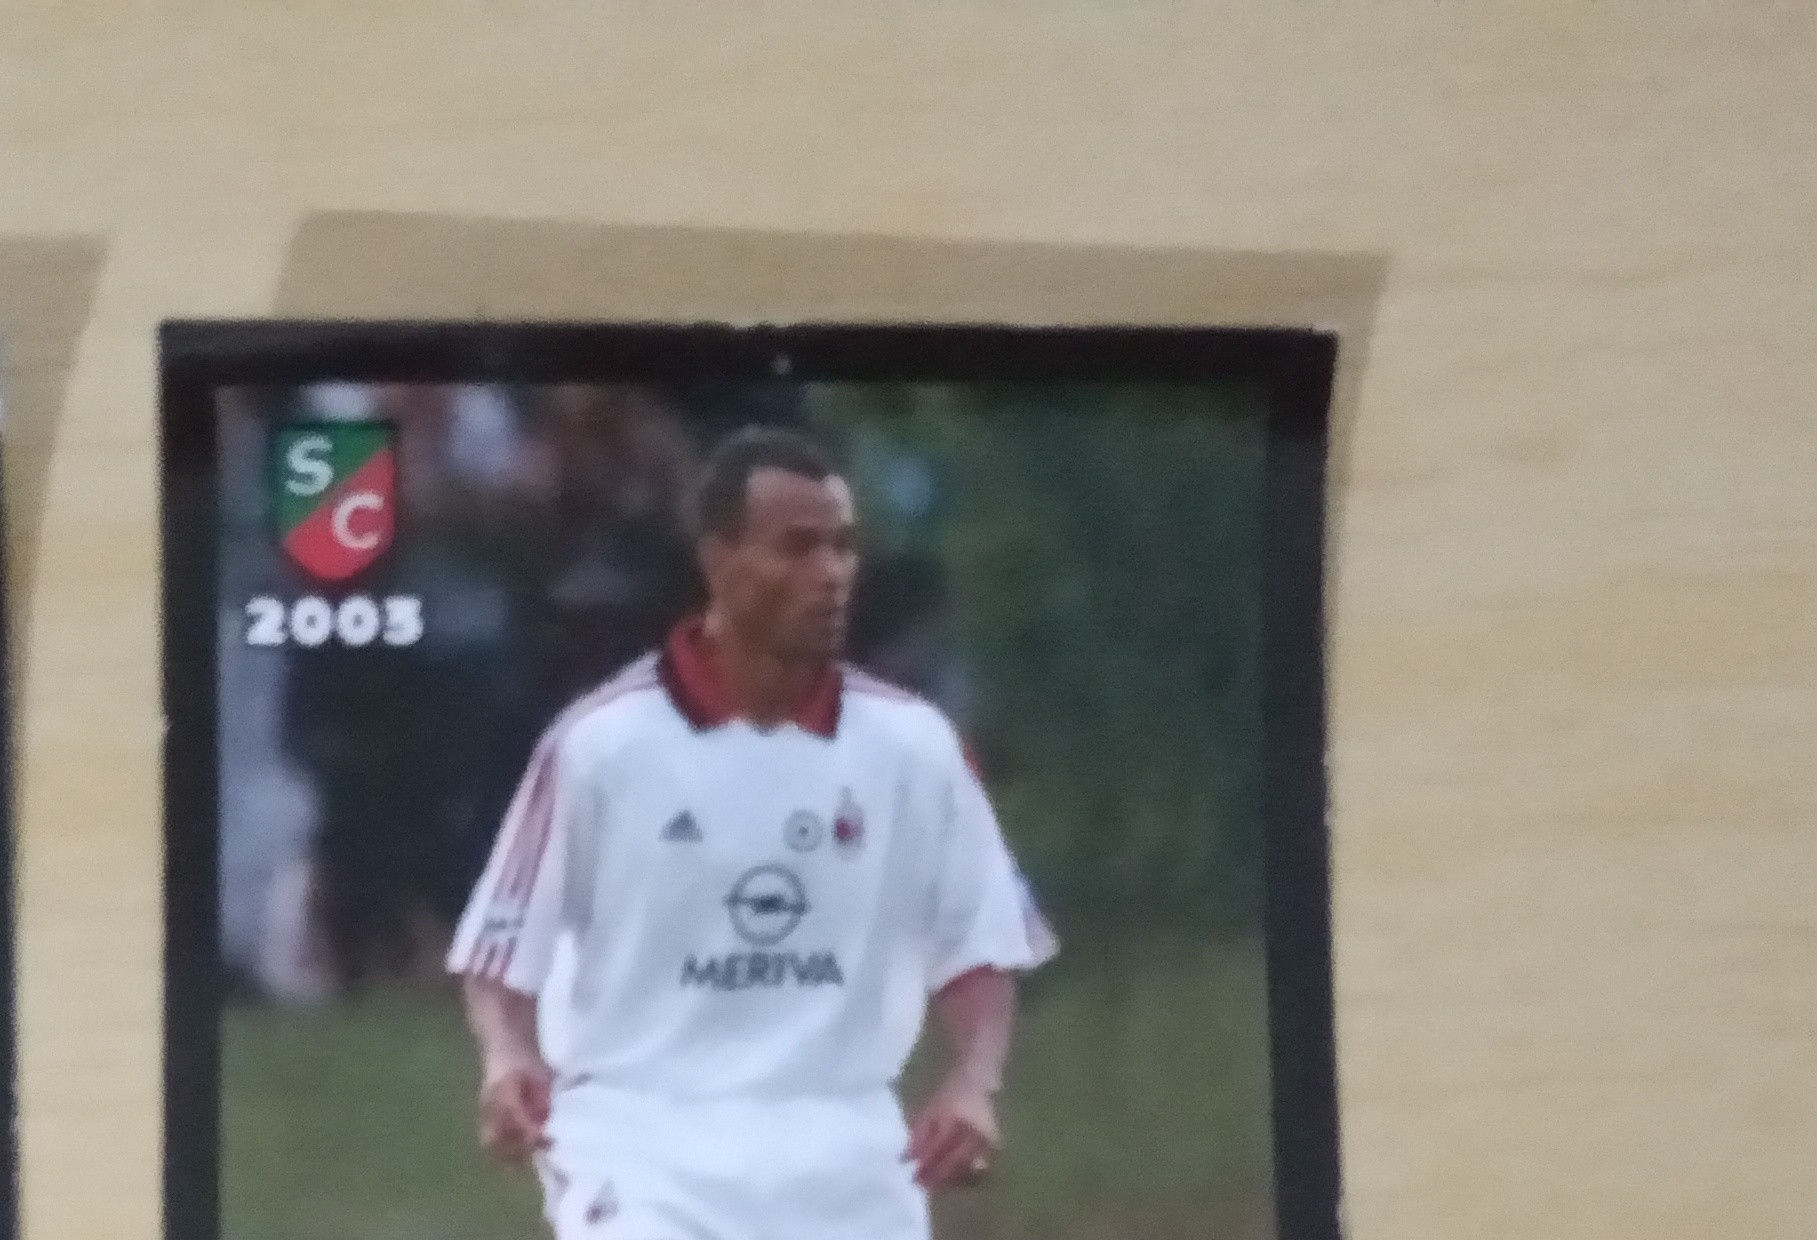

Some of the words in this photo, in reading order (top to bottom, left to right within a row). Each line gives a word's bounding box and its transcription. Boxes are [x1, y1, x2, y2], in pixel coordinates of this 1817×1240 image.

[286, 430, 334, 496] S
[333, 490, 384, 550] C
[680, 950, 845, 992] MERIVA
